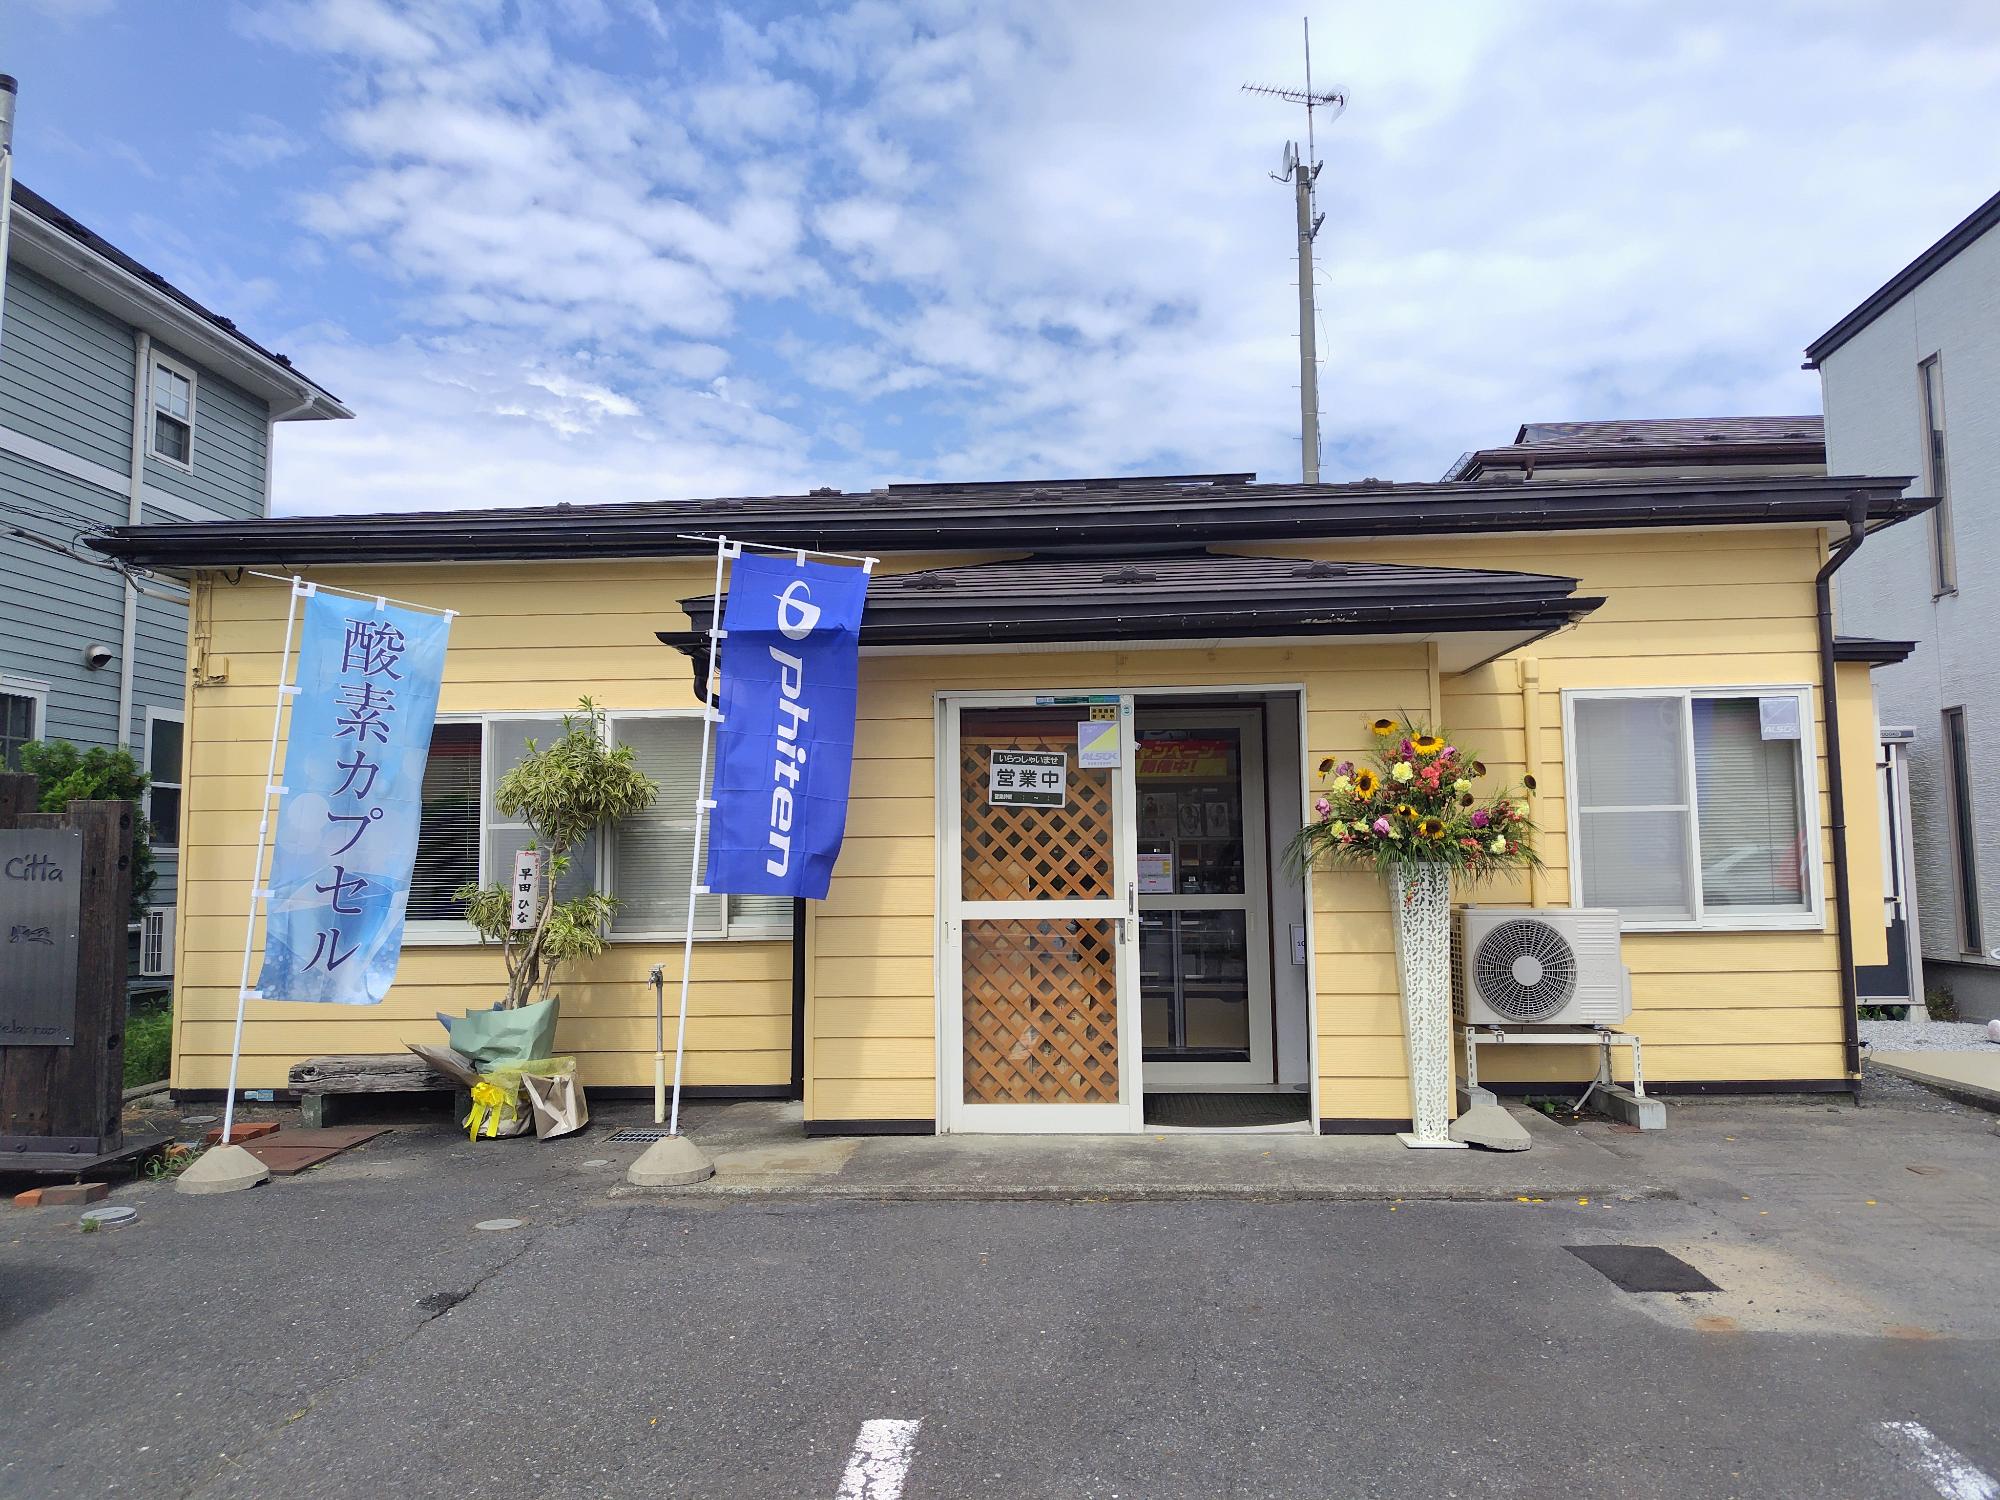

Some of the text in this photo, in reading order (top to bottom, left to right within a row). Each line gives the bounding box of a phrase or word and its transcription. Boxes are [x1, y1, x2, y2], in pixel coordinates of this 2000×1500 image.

[766, 645, 809, 878] phiten
[999, 754, 1059, 764] いらっしゃいませ
[1081, 752, 1119, 760] ALSOK
[1138, 744, 1216, 758] ャンペーン
[997, 768, 1059, 788] 営業中
[300, 617, 406, 973] 酸素カプセル
[5, 854, 64, 882] Citta
[517, 868, 533, 924] 早田ひな
